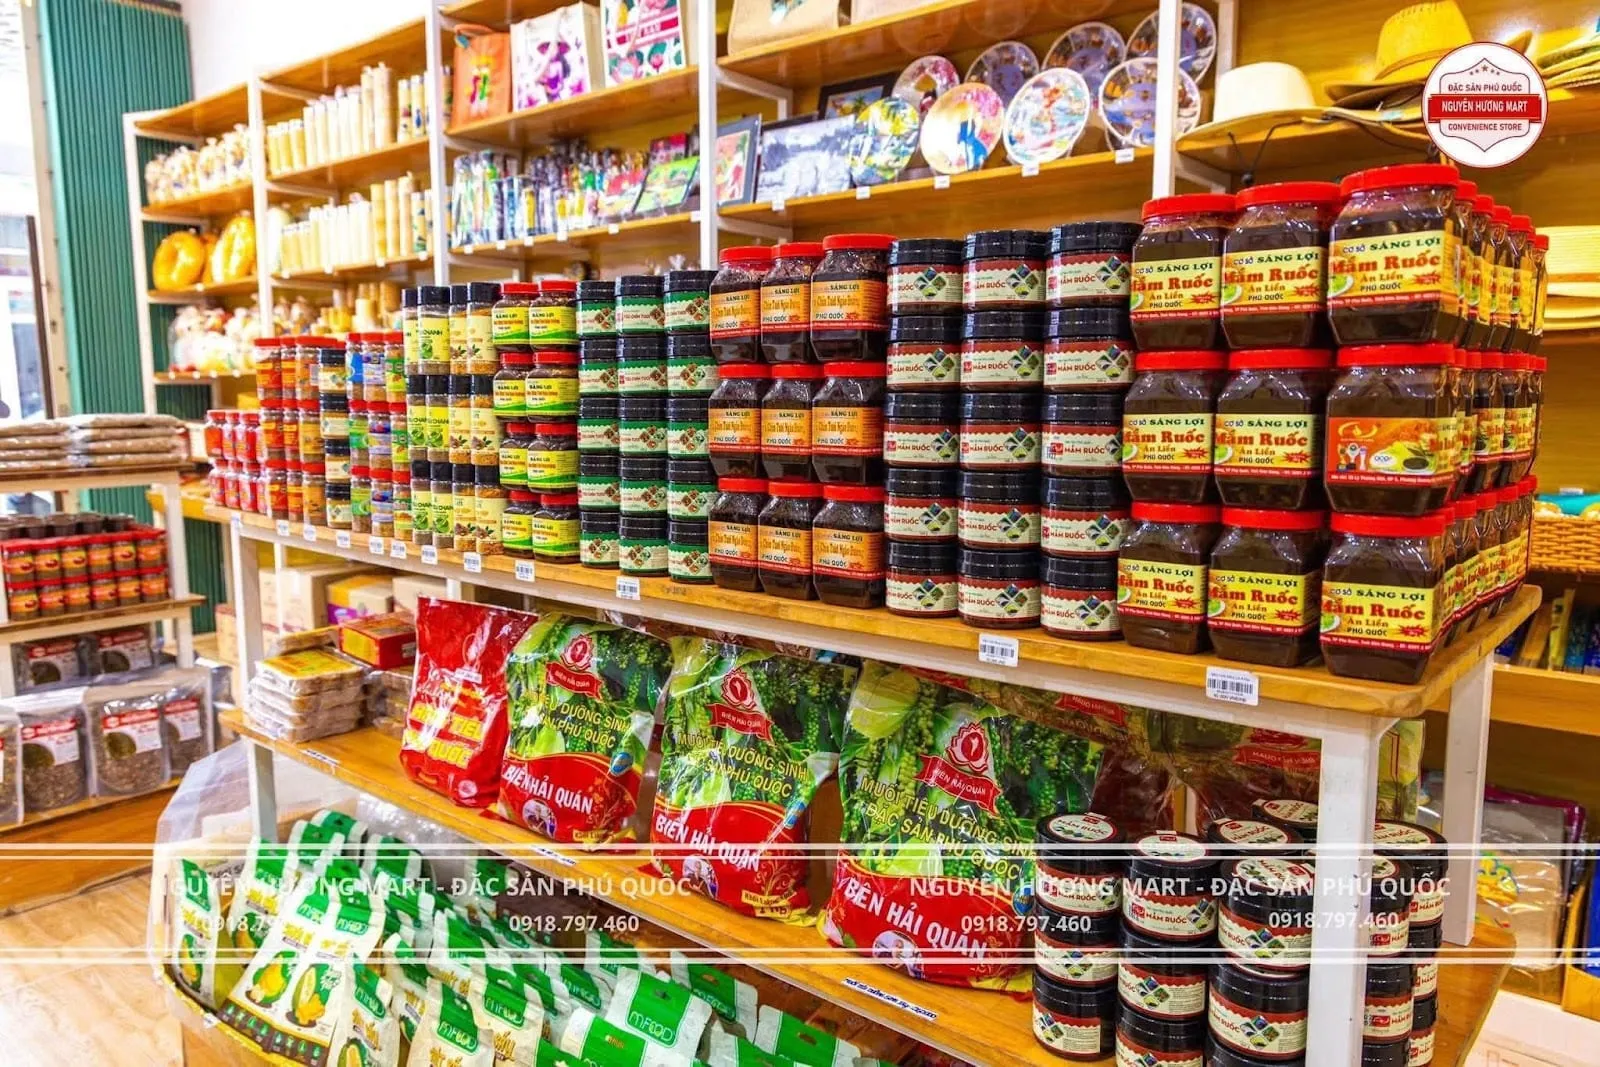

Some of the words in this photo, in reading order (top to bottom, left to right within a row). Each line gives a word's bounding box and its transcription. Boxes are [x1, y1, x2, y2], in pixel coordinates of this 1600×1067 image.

[1369, 240, 1411, 251] SÁNG
[1257, 253, 1292, 263] SÁNG
[1384, 250, 1440, 270] Ruốc
[1157, 263, 1189, 272] SÁNG
[1269, 264, 1318, 282] Ruốc
[1169, 273, 1213, 290] Ruốc
[1150, 418, 1182, 426] SÁNG
[1247, 418, 1282, 428] SÁNG
[1161, 428, 1205, 443] Ruốc
[1259, 430, 1308, 447] Ruốc
[1142, 565, 1174, 576] SÁNG
[1153, 578, 1194, 595] Ruốc
[1239, 575, 1273, 586] SÁNG
[1251, 588, 1298, 606] Ruốc
[1356, 588, 1396, 599] SÁNG
[1370, 602, 1425, 621] Ruốc
[561, 702, 602, 724] DƯỠNG
[557, 719, 582, 737] PHÚ
[585, 728, 616, 749] QUỐC
[778, 760, 808, 782] SINH
[753, 773, 793, 798] QUỐC
[529, 775, 554, 800] HẢI
[555, 787, 593, 814] QUÁN
[860, 777, 900, 803] MUỐI
[905, 794, 938, 820] TIÊU
[940, 809, 998, 844] DƯỠNG
[866, 802, 898, 828] ĐẶC
[901, 816, 933, 842] SẢN
[971, 847, 1020, 879] QUỐC
[887, 902, 923, 935] HẢI
[926, 921, 988, 960] QUÁN
